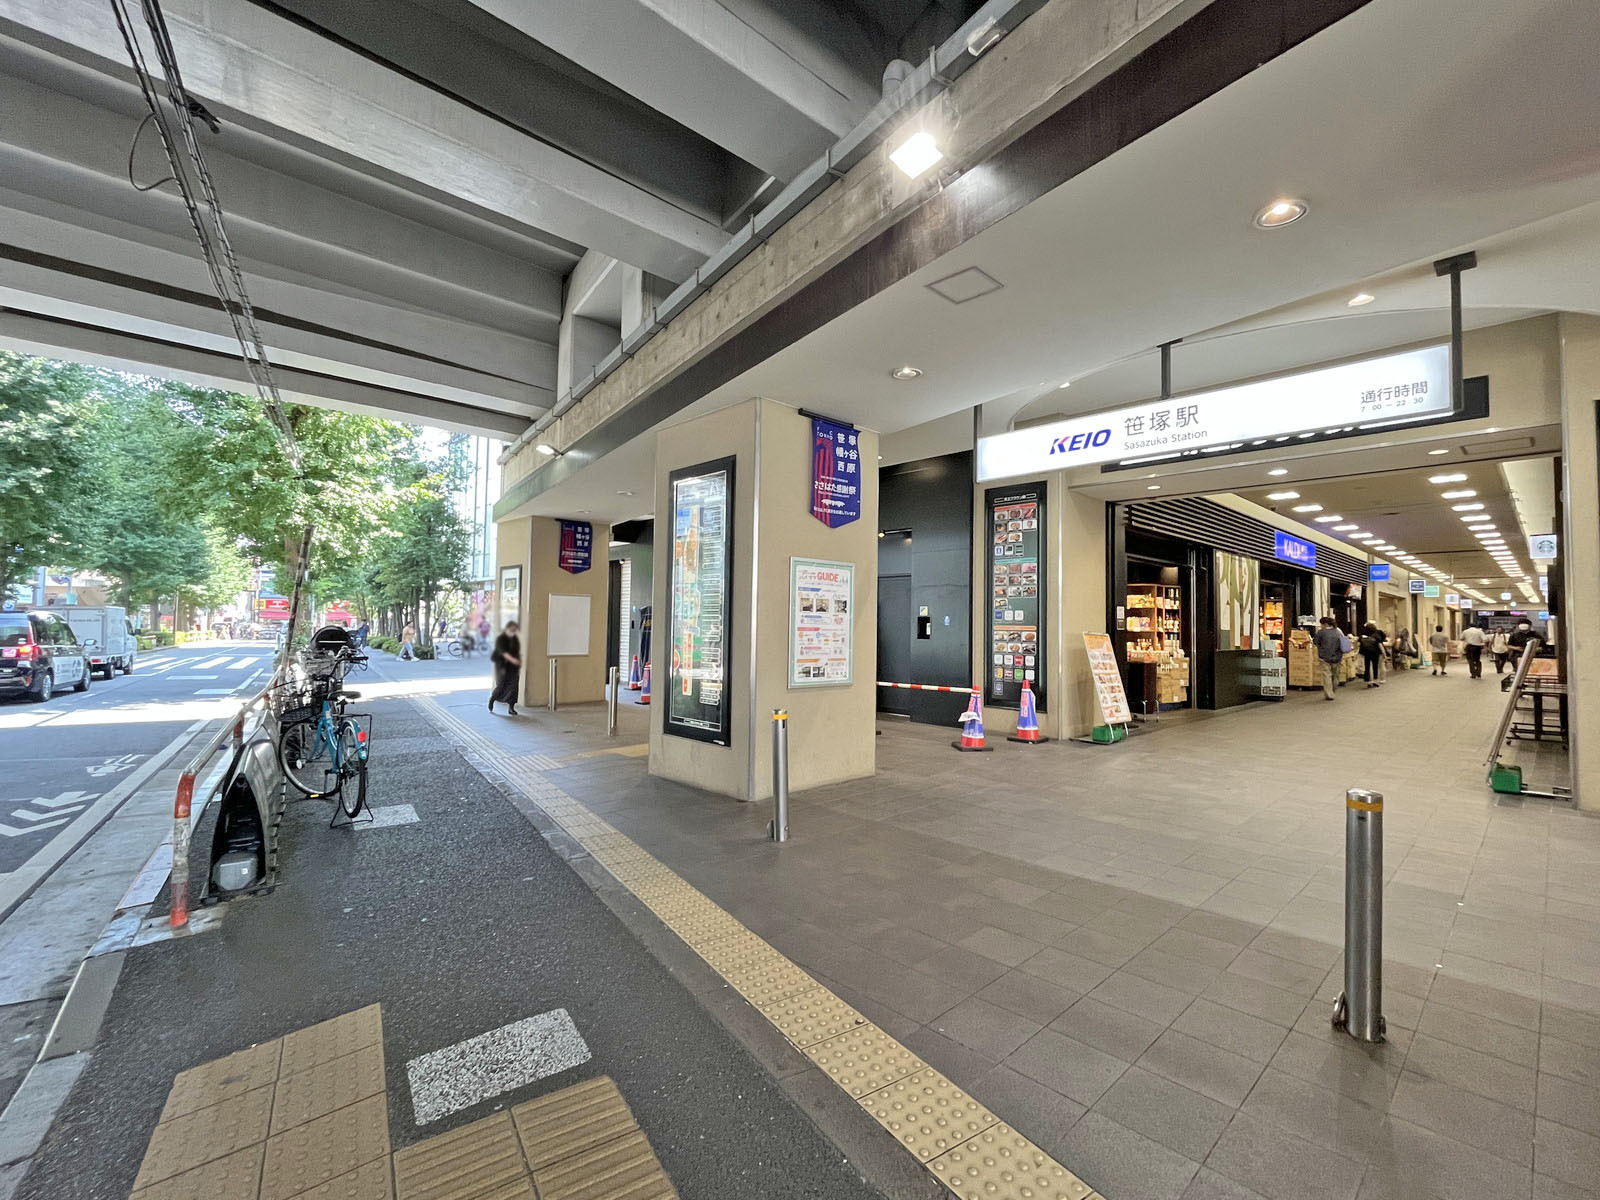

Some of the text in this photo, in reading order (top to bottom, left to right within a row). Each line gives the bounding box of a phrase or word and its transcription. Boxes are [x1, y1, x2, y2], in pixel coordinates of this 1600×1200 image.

[1360, 380, 1428, 404] 通行時間
[1124, 404, 1199, 436] 笹塚駅
[1049, 428, 1112, 455] KEIO
[1124, 429, 1208, 451] Sasazuka Station
[817, 571, 840, 583] GUIDE
